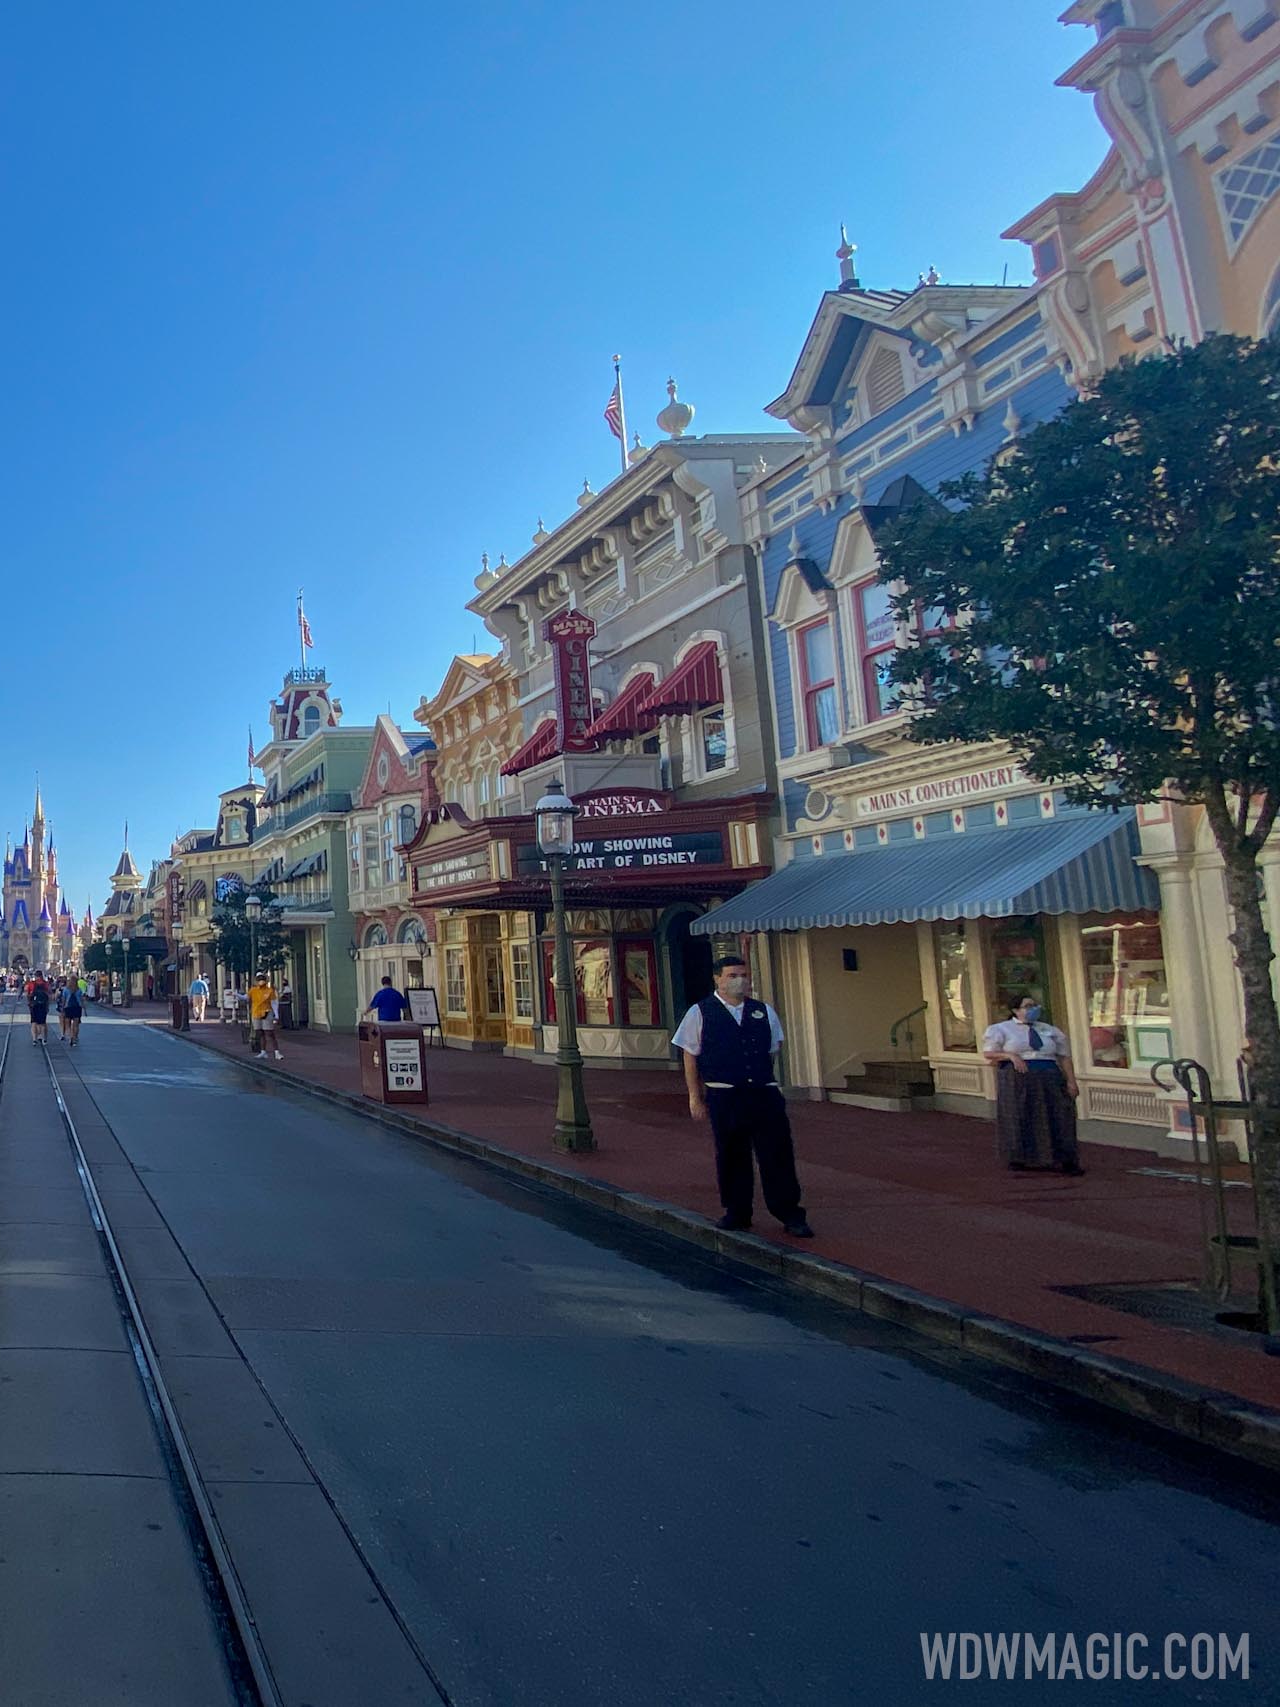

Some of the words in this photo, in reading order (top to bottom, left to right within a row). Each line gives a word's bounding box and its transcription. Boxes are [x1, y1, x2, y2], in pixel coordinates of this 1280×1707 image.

[553, 620, 589, 633] MAIN
[565, 639, 590, 737] CINEMA
[869, 791, 898, 812] MAIN
[898, 788, 914, 808] ST.
[916, 765, 1015, 803] CONFECTIONERY
[588, 796, 621, 806] MAIN
[622, 795, 637, 804] ST
[603, 836, 673, 853] SHOWING
[577, 856, 606, 870] ART
[614, 854, 633, 867] OF
[642, 851, 697, 867] DISNEY
